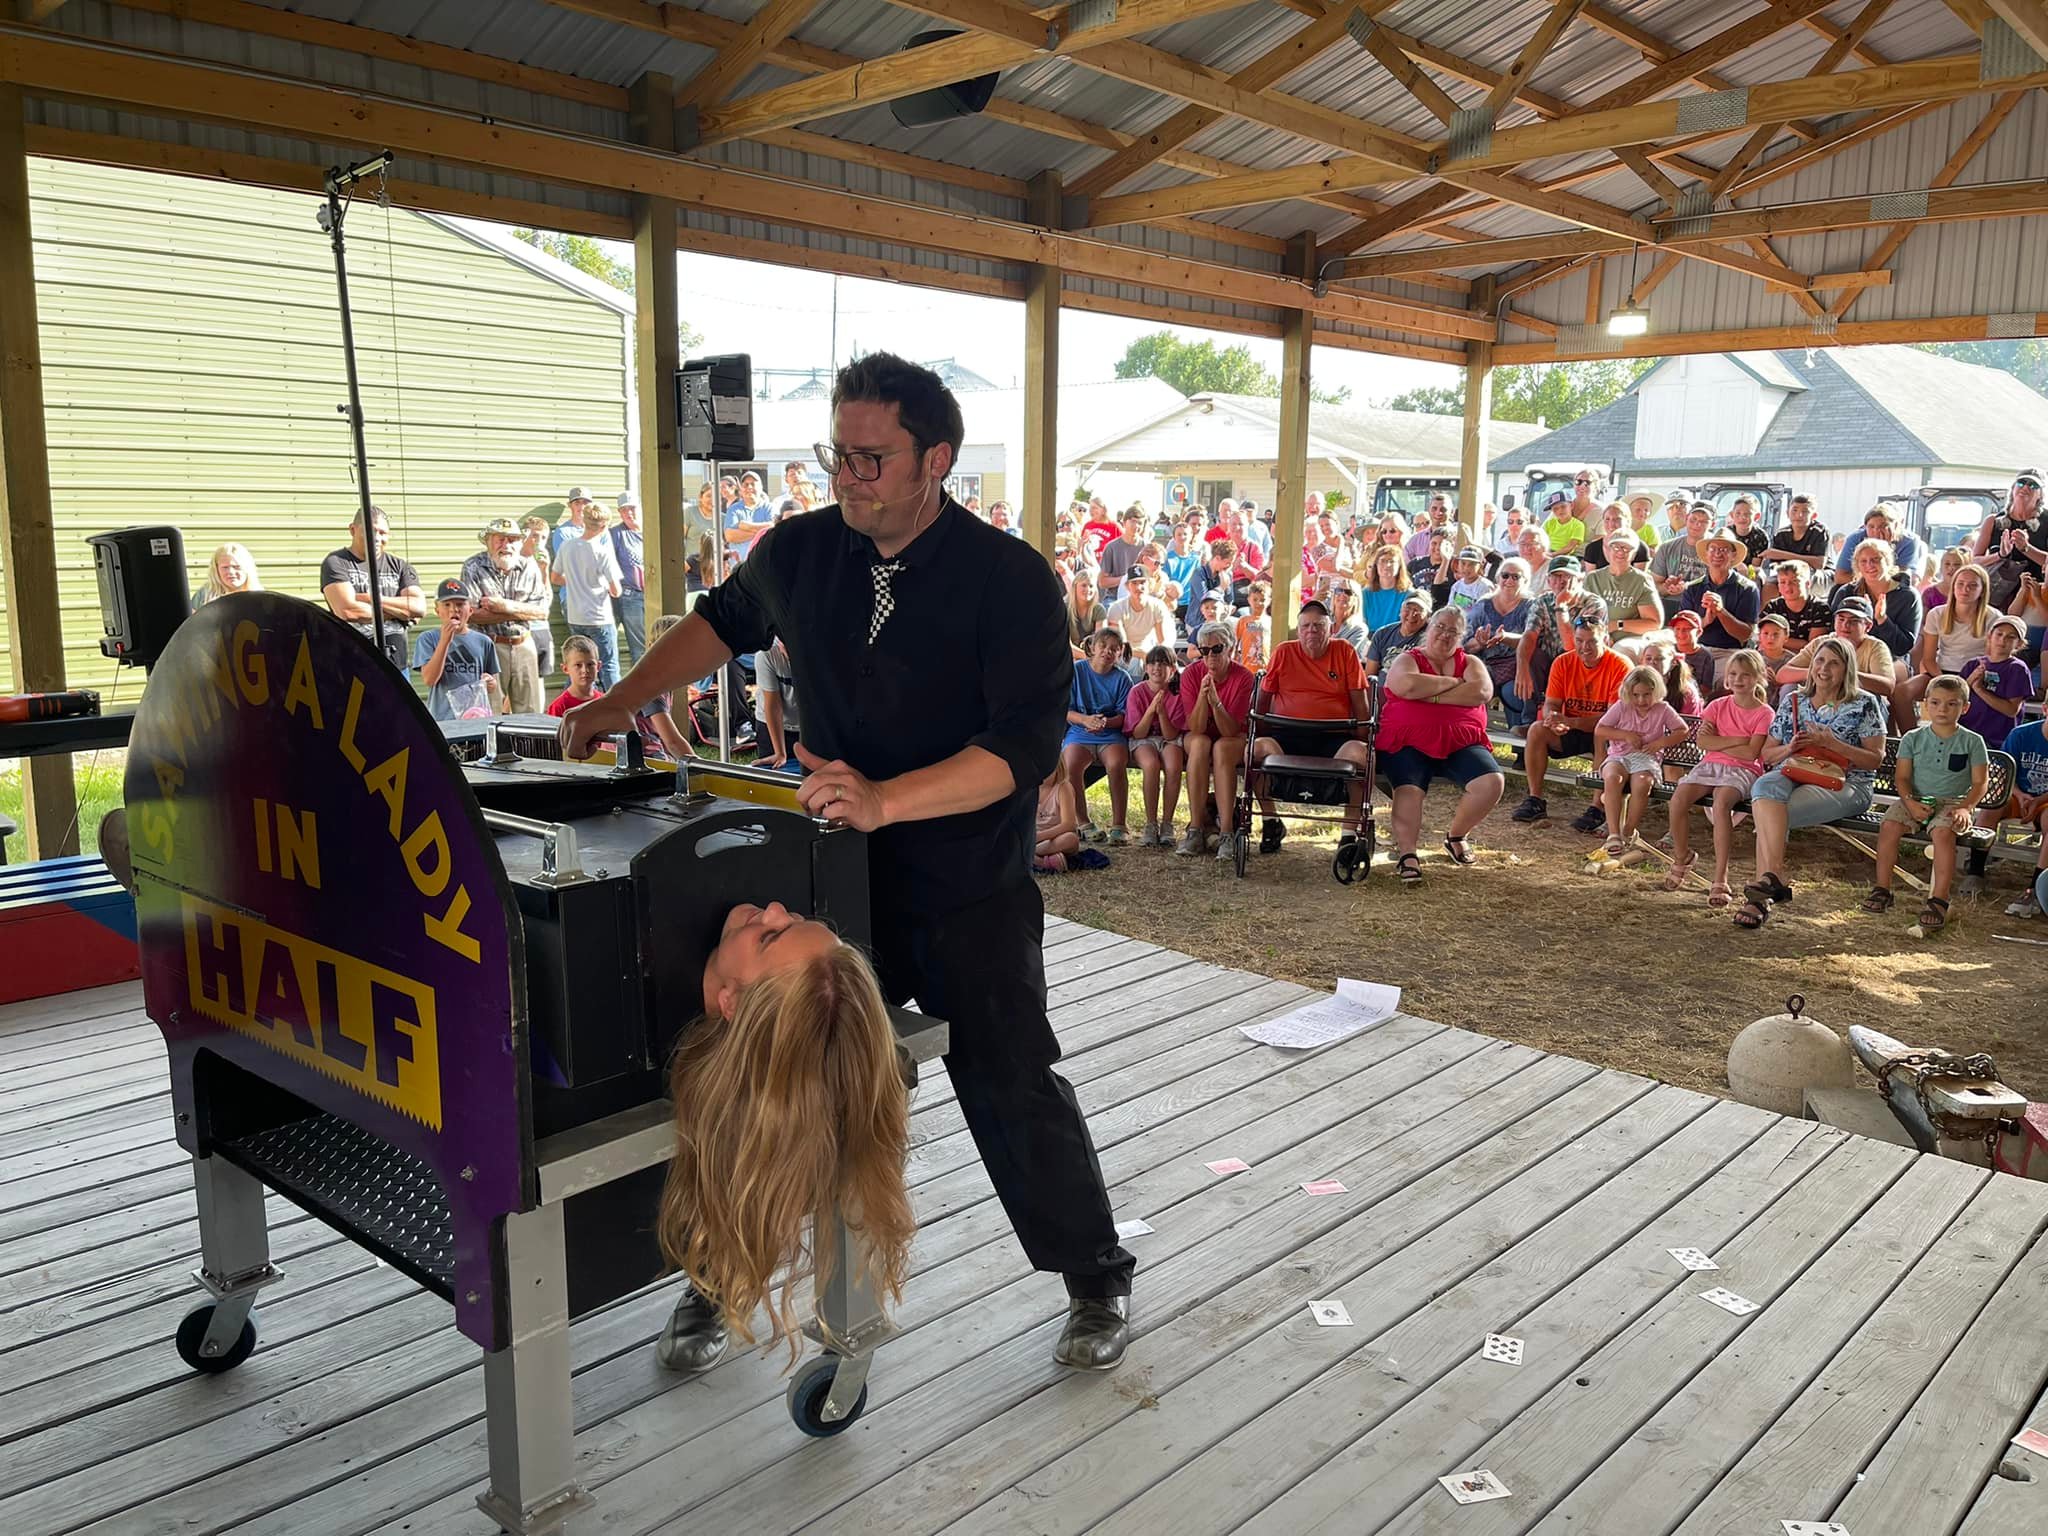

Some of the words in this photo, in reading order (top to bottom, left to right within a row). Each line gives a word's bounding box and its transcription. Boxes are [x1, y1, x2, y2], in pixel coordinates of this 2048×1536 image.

[137, 619, 270, 865] SAWING
[286, 630, 324, 730] A
[339, 675, 480, 963] LADY
[253, 798, 321, 889] IN
[195, 912, 422, 1089] HALF
